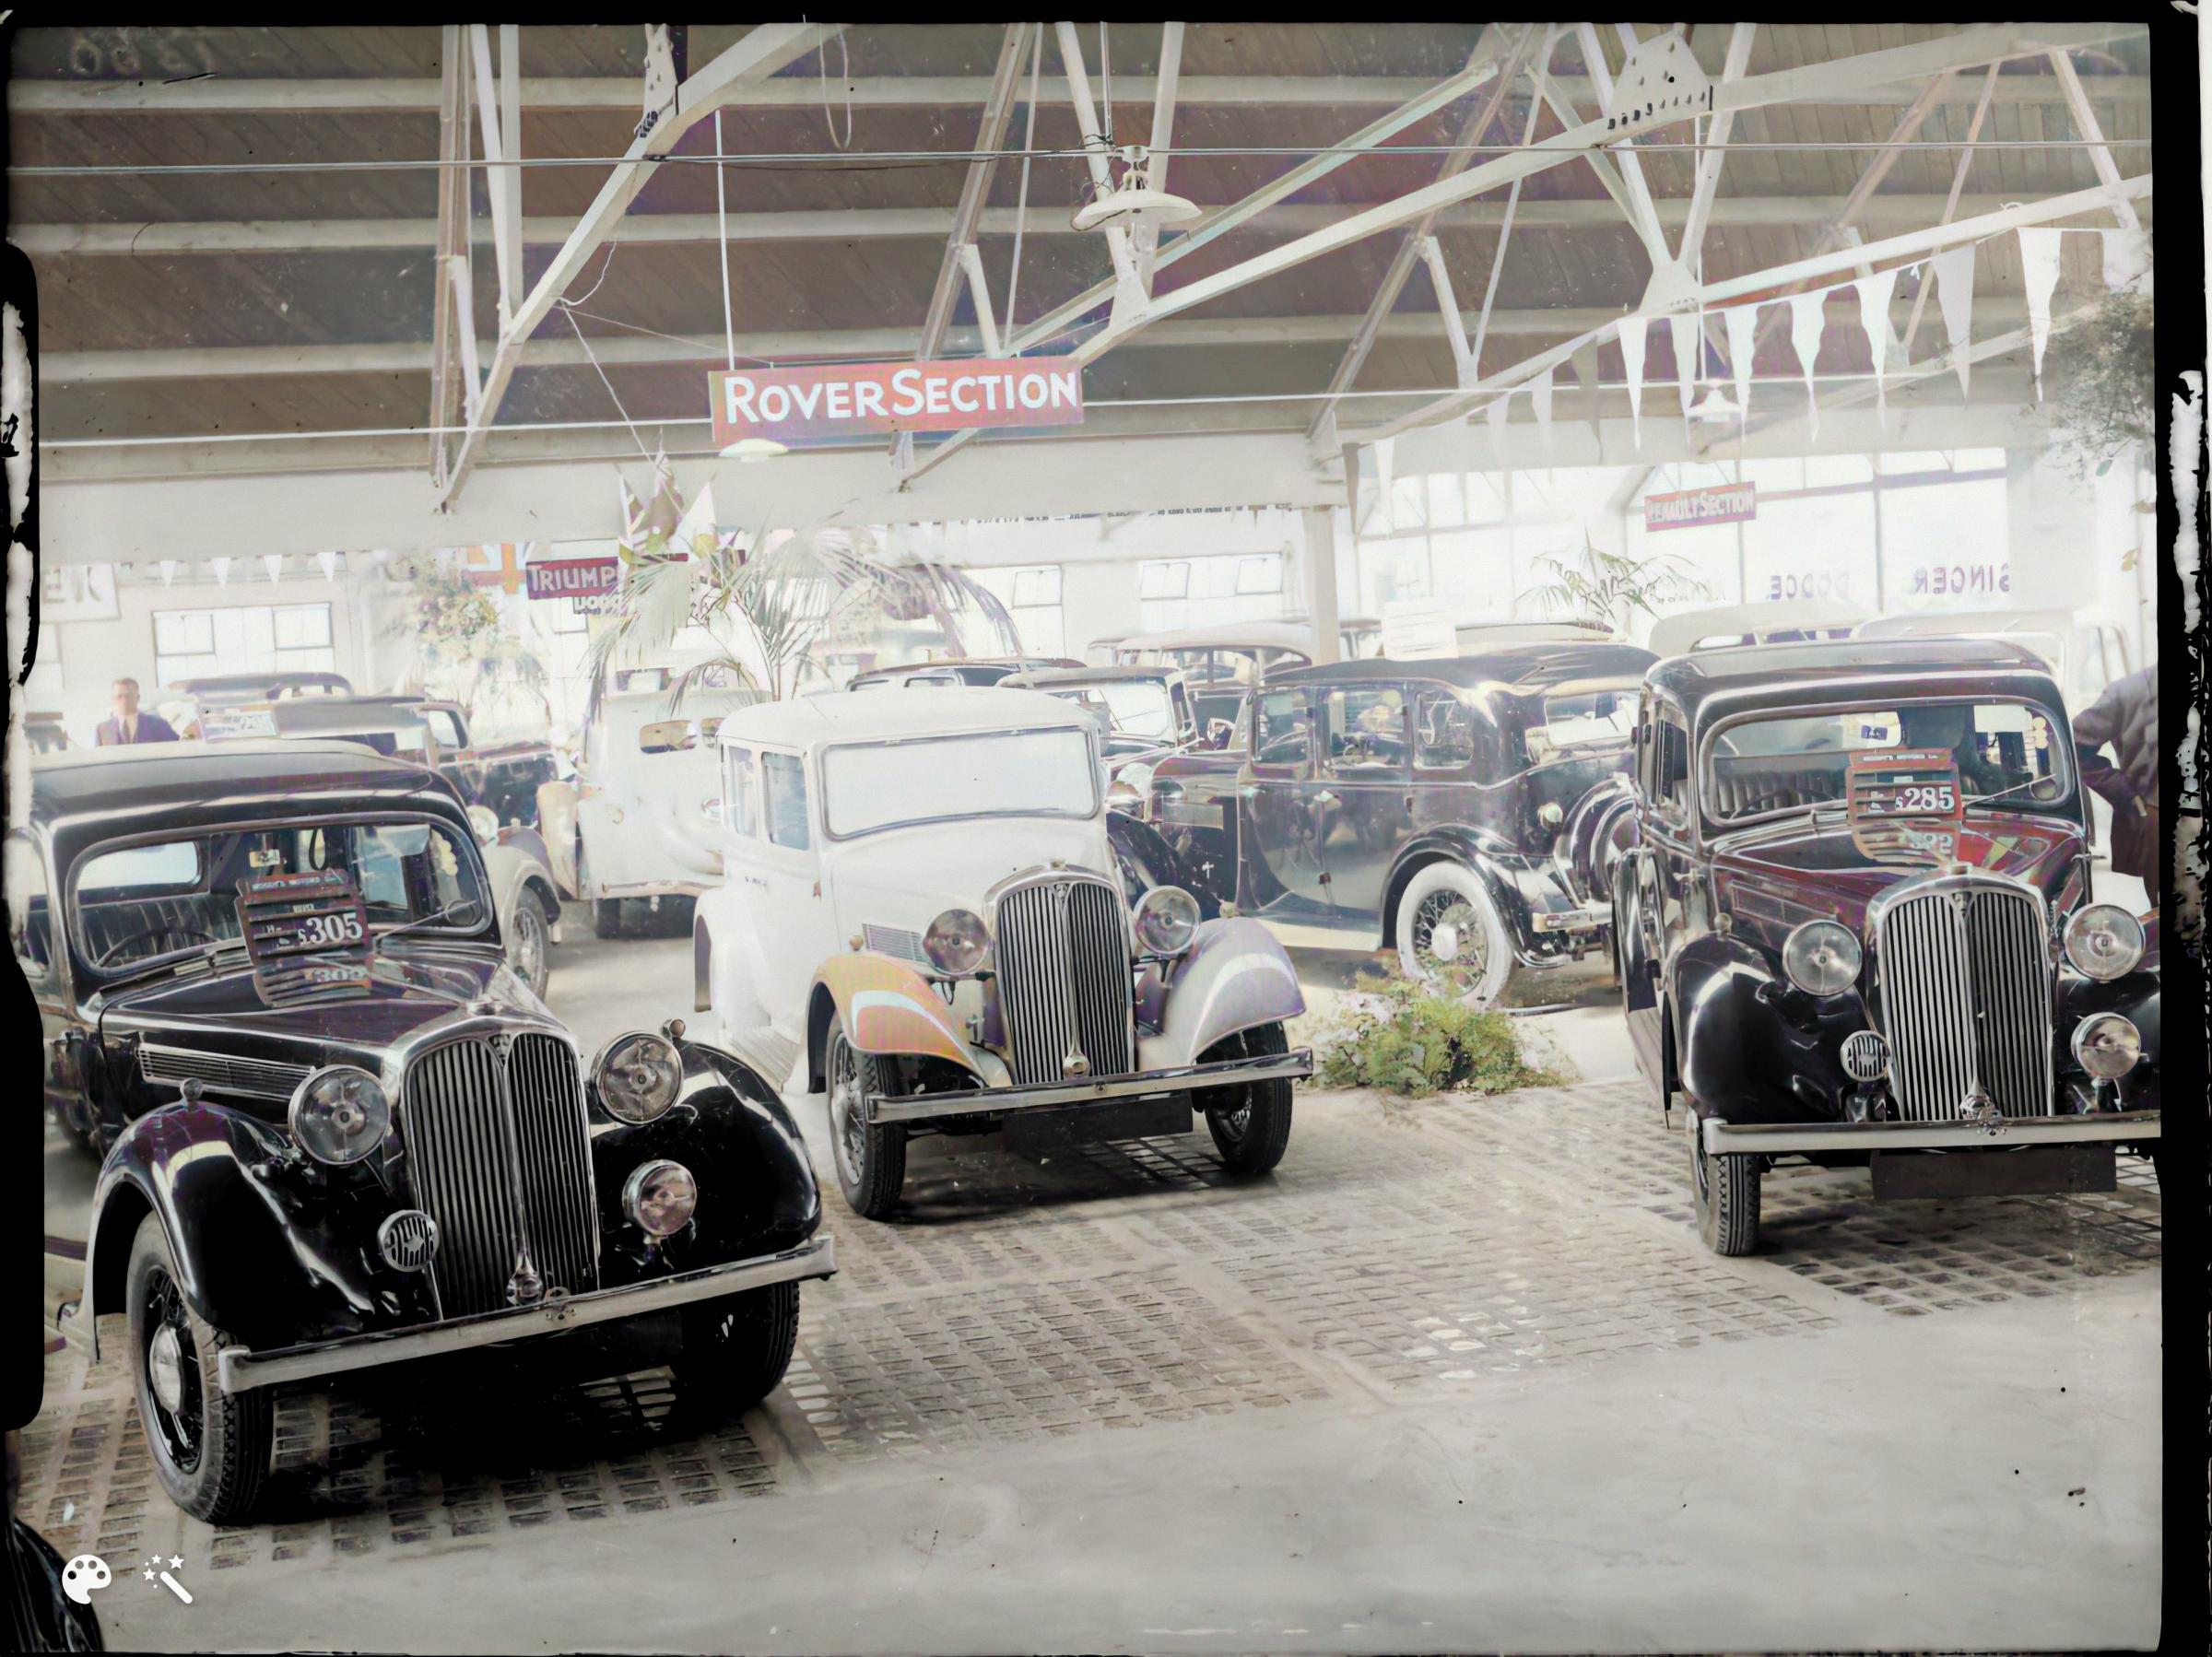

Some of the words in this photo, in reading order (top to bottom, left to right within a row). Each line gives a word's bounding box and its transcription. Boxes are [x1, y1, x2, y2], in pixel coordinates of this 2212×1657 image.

[724, 376, 889, 424] ROVER
[891, 369, 1077, 416] SECTION
[1700, 489, 1754, 517] SECTION
[526, 565, 618, 592] TRIUMP
[298, 912, 363, 946] £305
